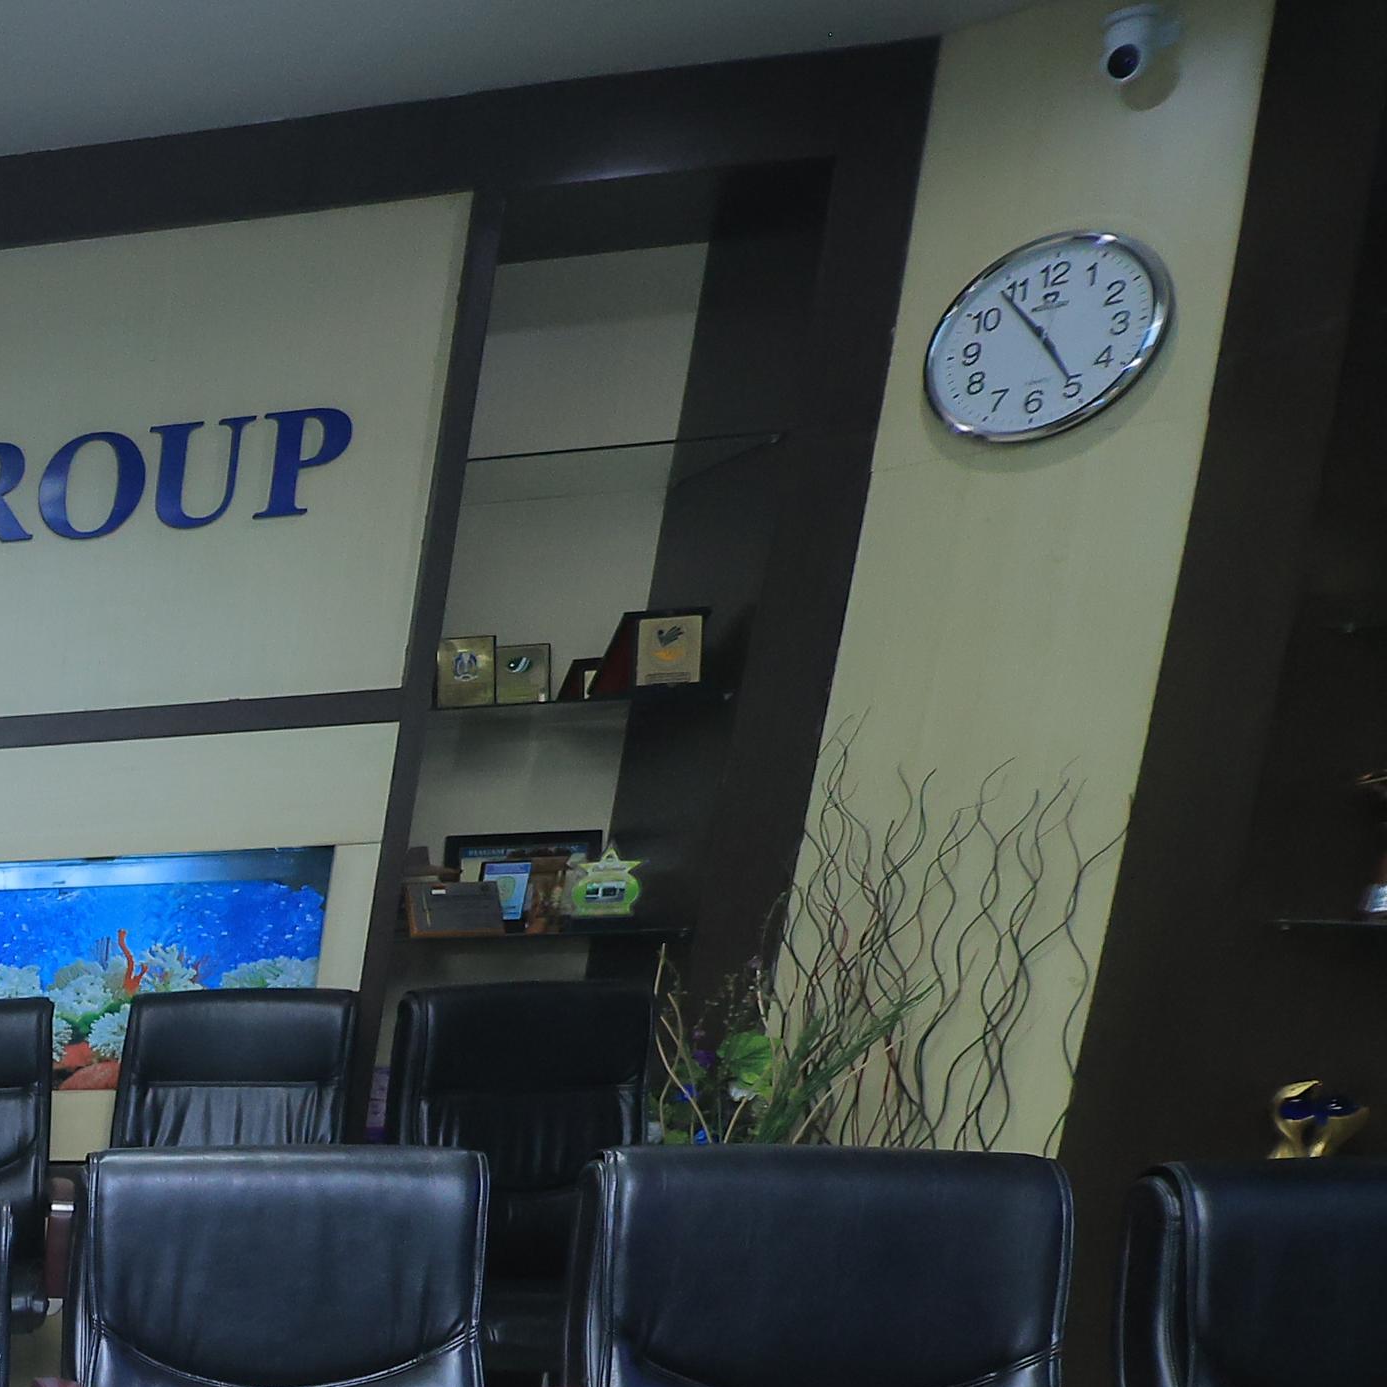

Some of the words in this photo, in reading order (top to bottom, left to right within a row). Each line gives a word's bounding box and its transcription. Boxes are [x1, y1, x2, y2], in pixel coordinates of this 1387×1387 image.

[1040, 261, 1071, 288] 12
[1086, 262, 1098, 287] 1
[1006, 278, 1029, 302] 11
[1103, 280, 1126, 306] 2
[972, 307, 1001, 334] 10
[1109, 310, 1131, 336] 3
[962, 342, 982, 366] 9
[1092, 345, 1114, 368] 4
[966, 371, 986, 395] 8
[1063, 373, 1083, 398] 5
[991, 388, 1010, 413] 7
[1024, 389, 1044, 414] 6
